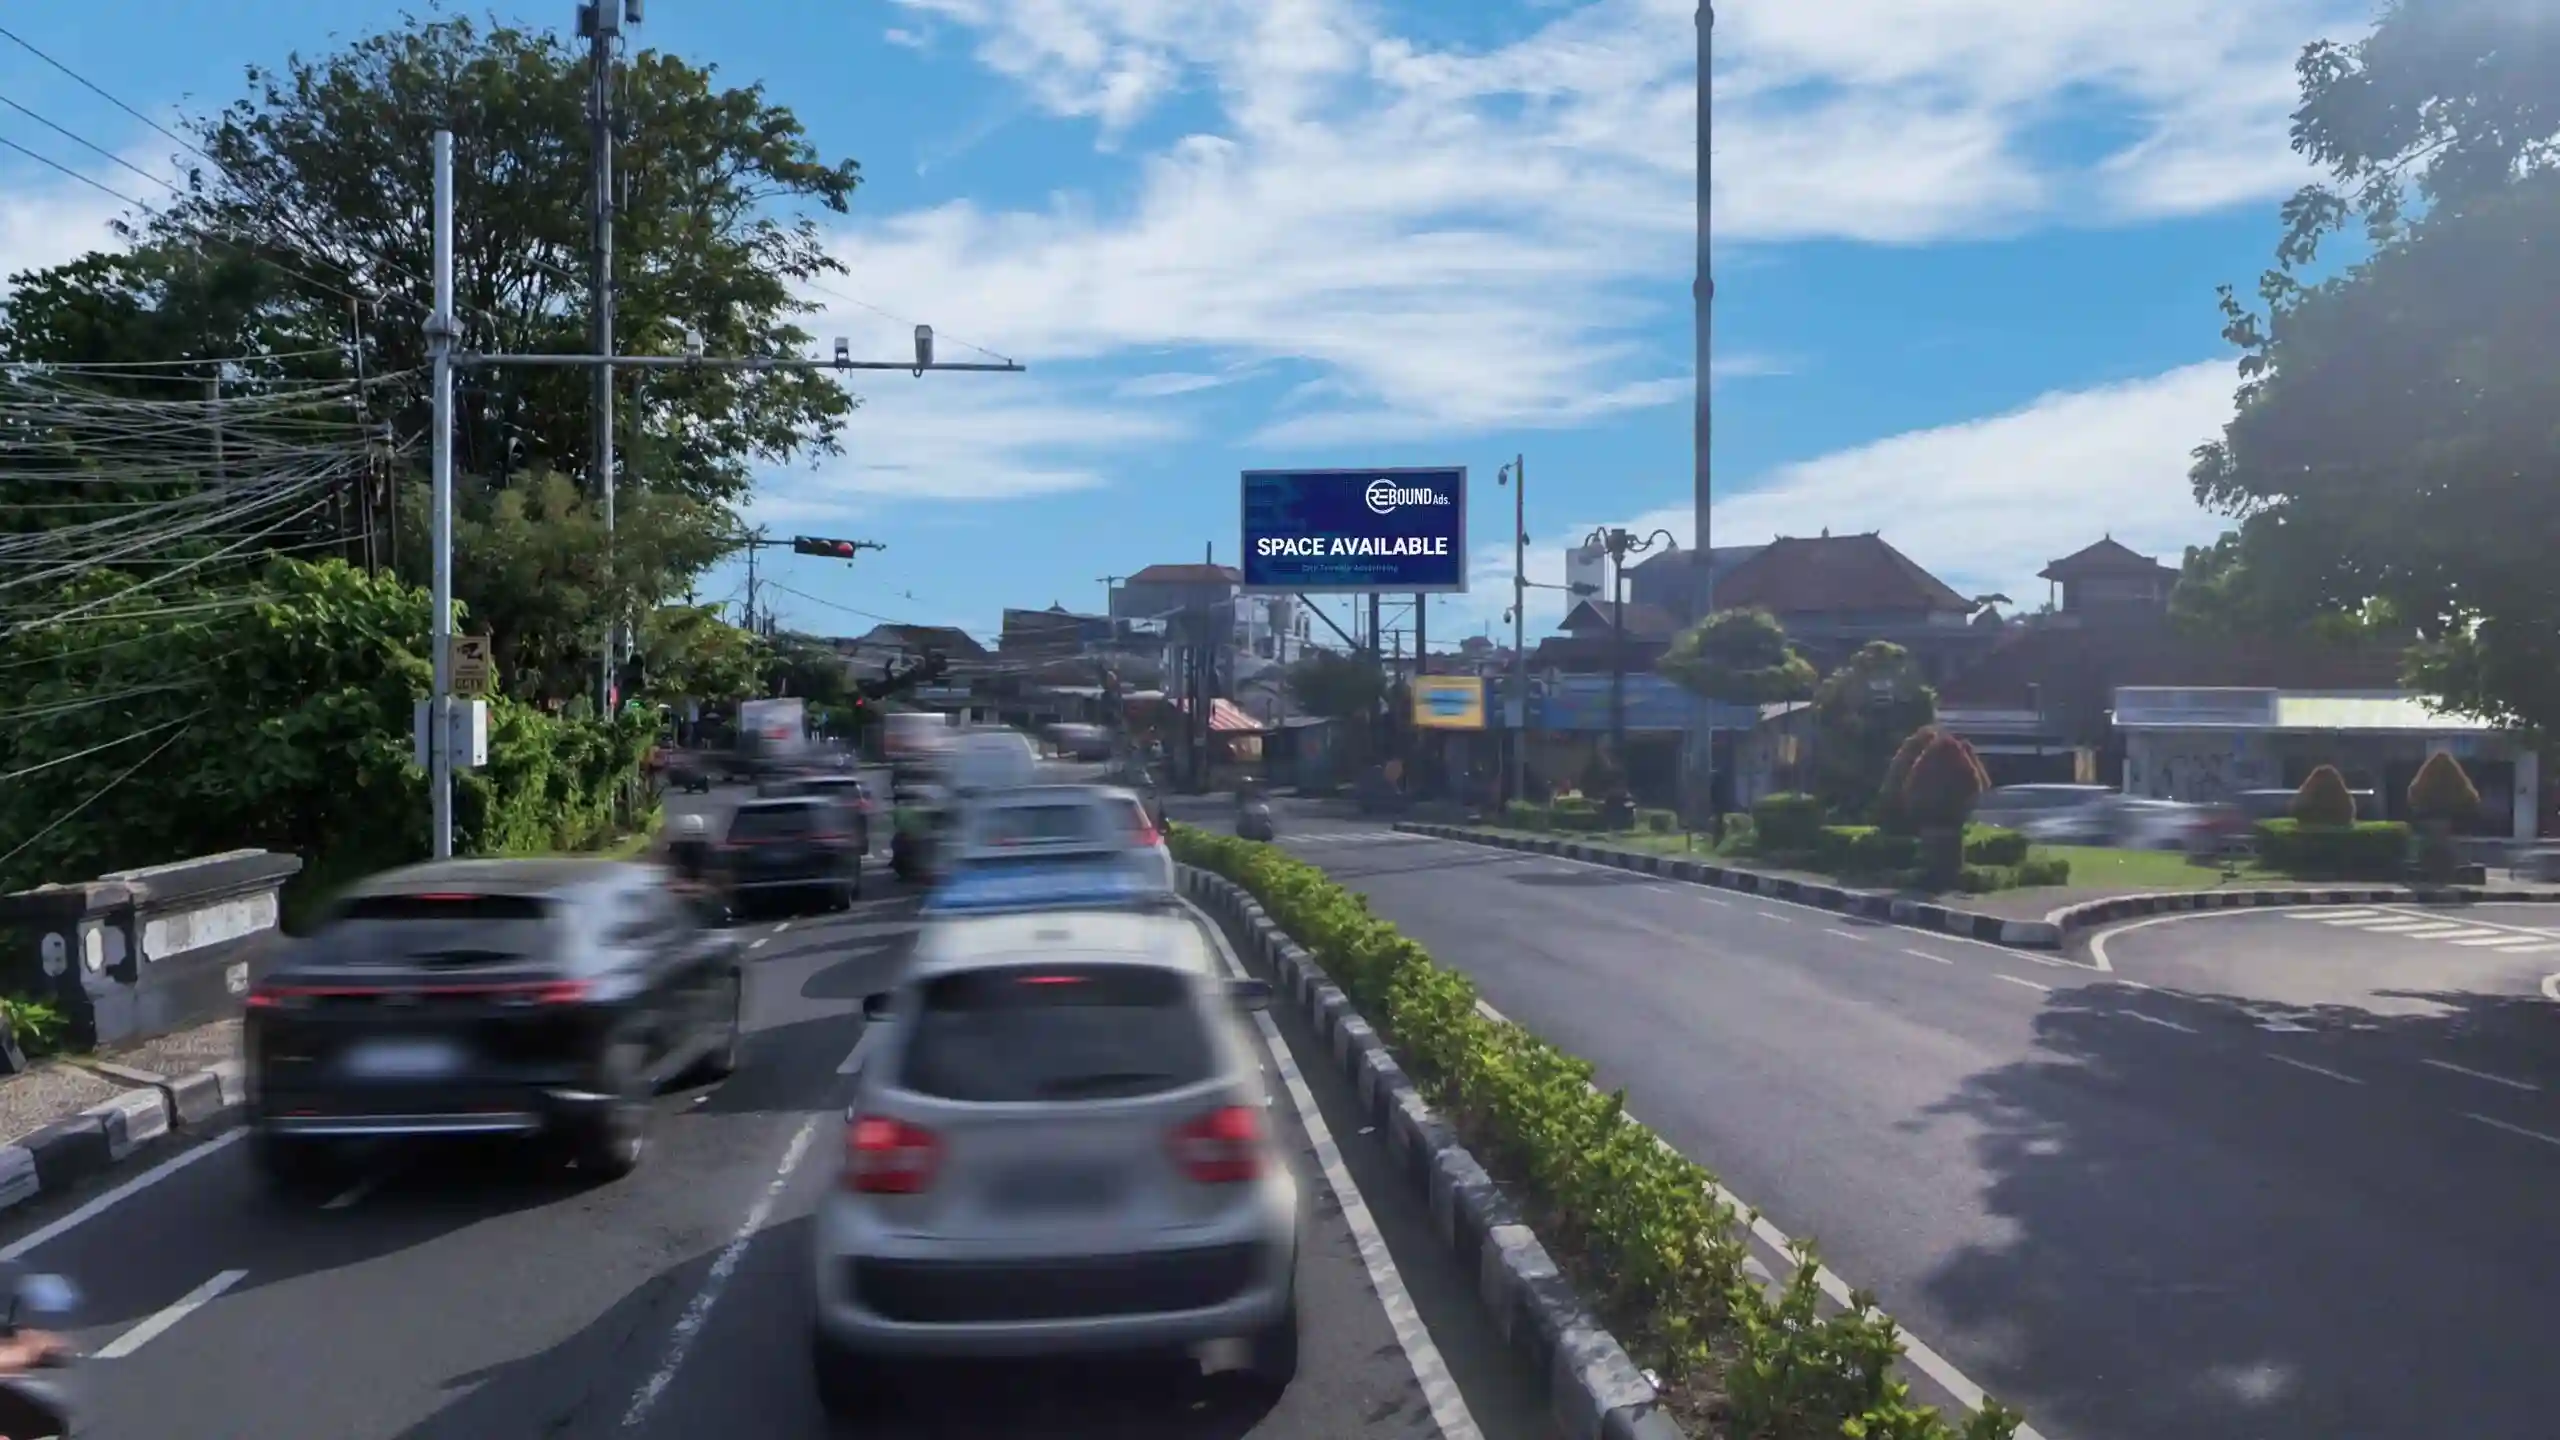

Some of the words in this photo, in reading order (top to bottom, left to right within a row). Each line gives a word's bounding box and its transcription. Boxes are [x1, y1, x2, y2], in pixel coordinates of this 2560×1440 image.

[1366, 487, 1432, 506] REBOUND
[1433, 494, 1451, 505] Ads.
[1257, 537, 1325, 556] SPACE
[1330, 537, 1448, 556] AVAILABLE
